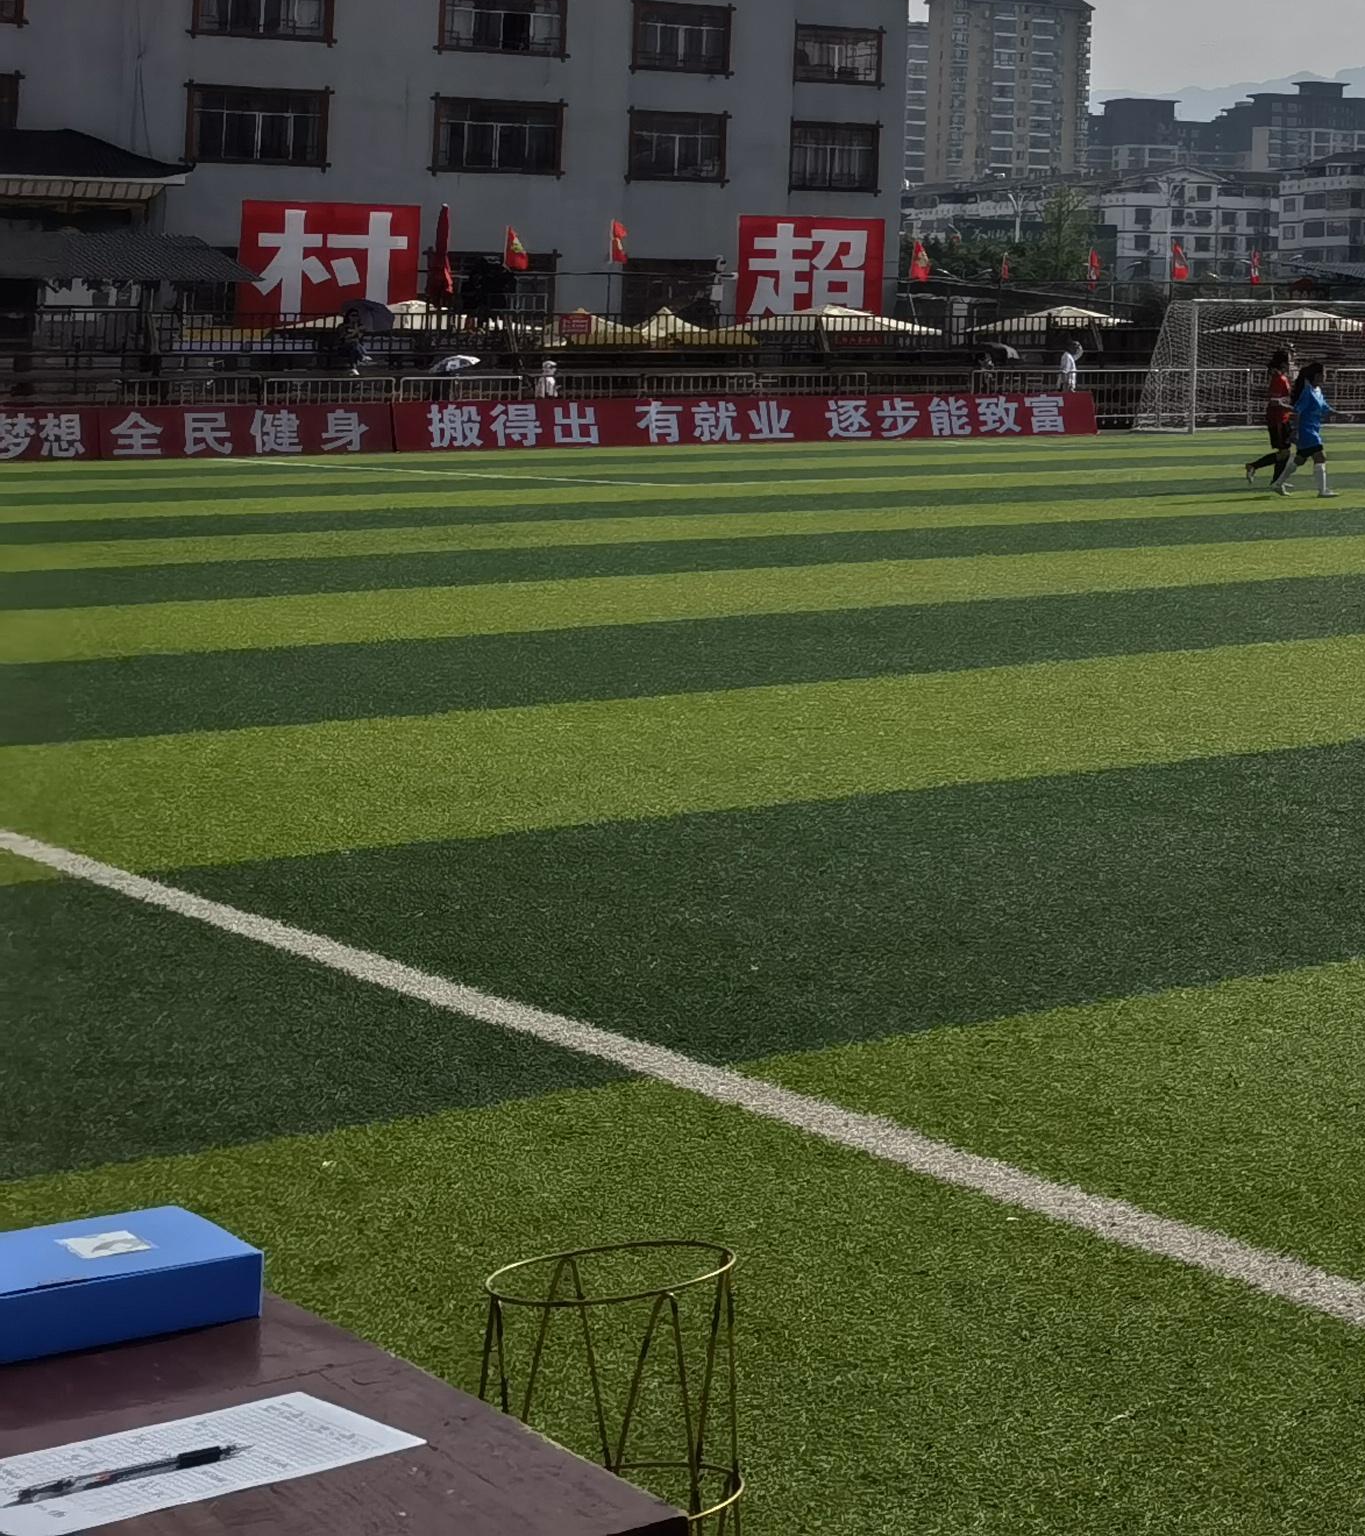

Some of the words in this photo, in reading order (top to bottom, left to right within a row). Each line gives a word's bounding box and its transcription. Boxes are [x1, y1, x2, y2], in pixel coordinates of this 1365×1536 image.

[252, 209, 407, 322] 村
[746, 223, 868, 316] 超
[111, 408, 368, 455] 全民健身
[428, 402, 599, 449] 搬得出
[636, 400, 794, 442] 有就业
[826, 394, 1065, 438] 逐步能致富
